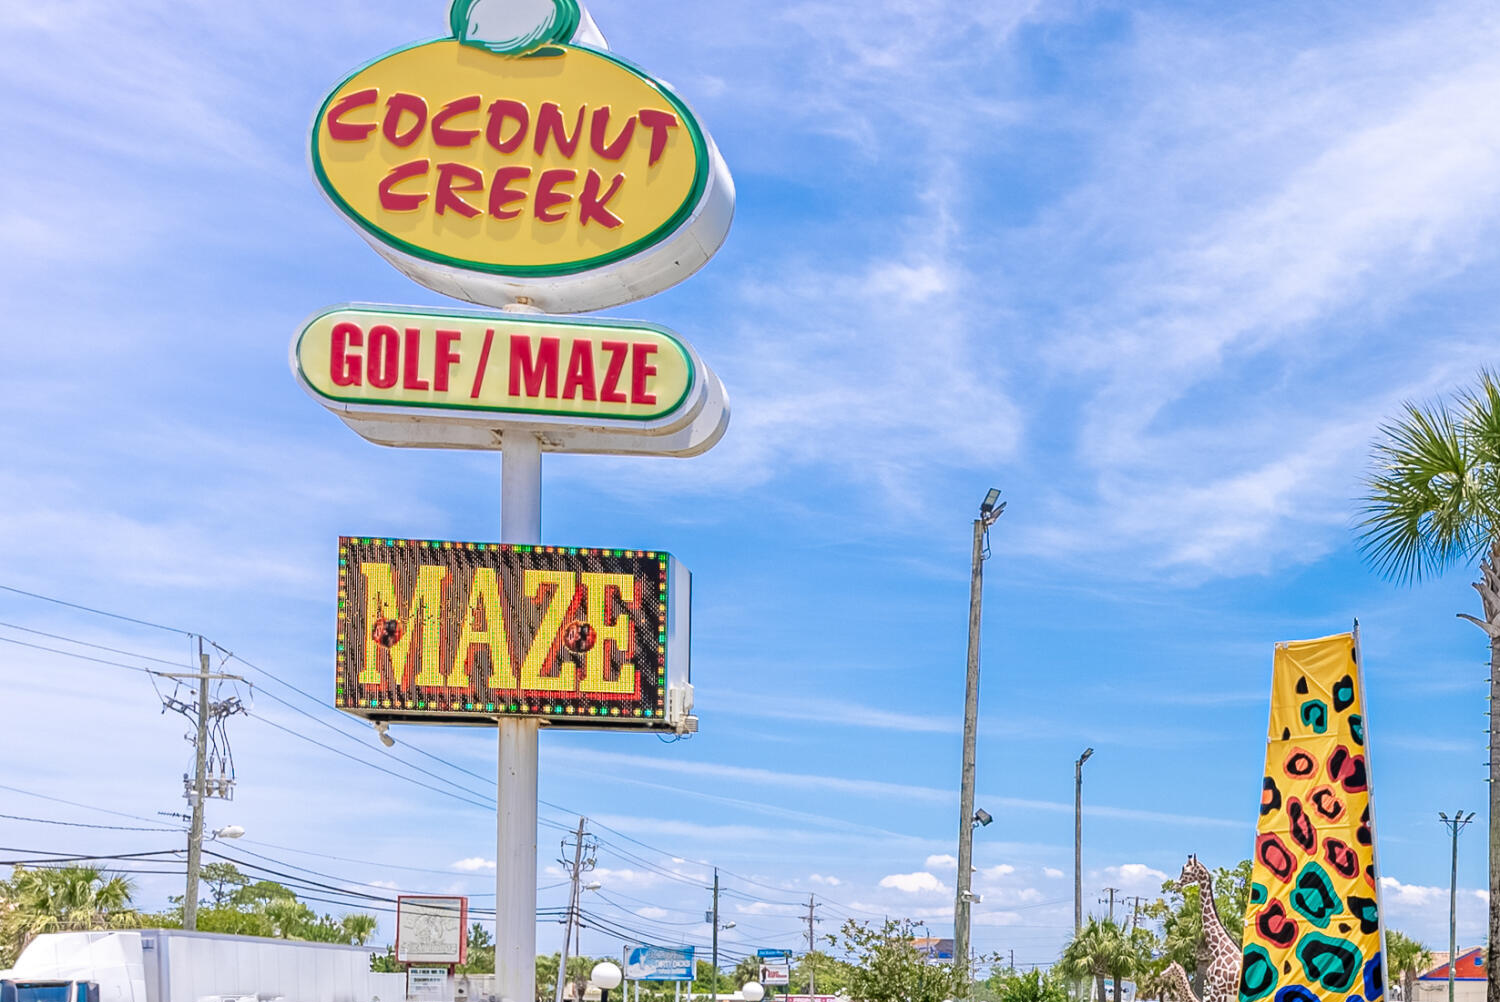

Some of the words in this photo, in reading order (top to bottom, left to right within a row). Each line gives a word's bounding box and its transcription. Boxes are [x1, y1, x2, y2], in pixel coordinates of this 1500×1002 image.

[327, 89, 679, 167] COCONUT
[379, 159, 625, 229] CREEK
[330, 322, 462, 392] GOLF
[470, 328, 495, 399] /
[508, 335, 659, 406] MAZE
[358, 562, 638, 696] MAZE
